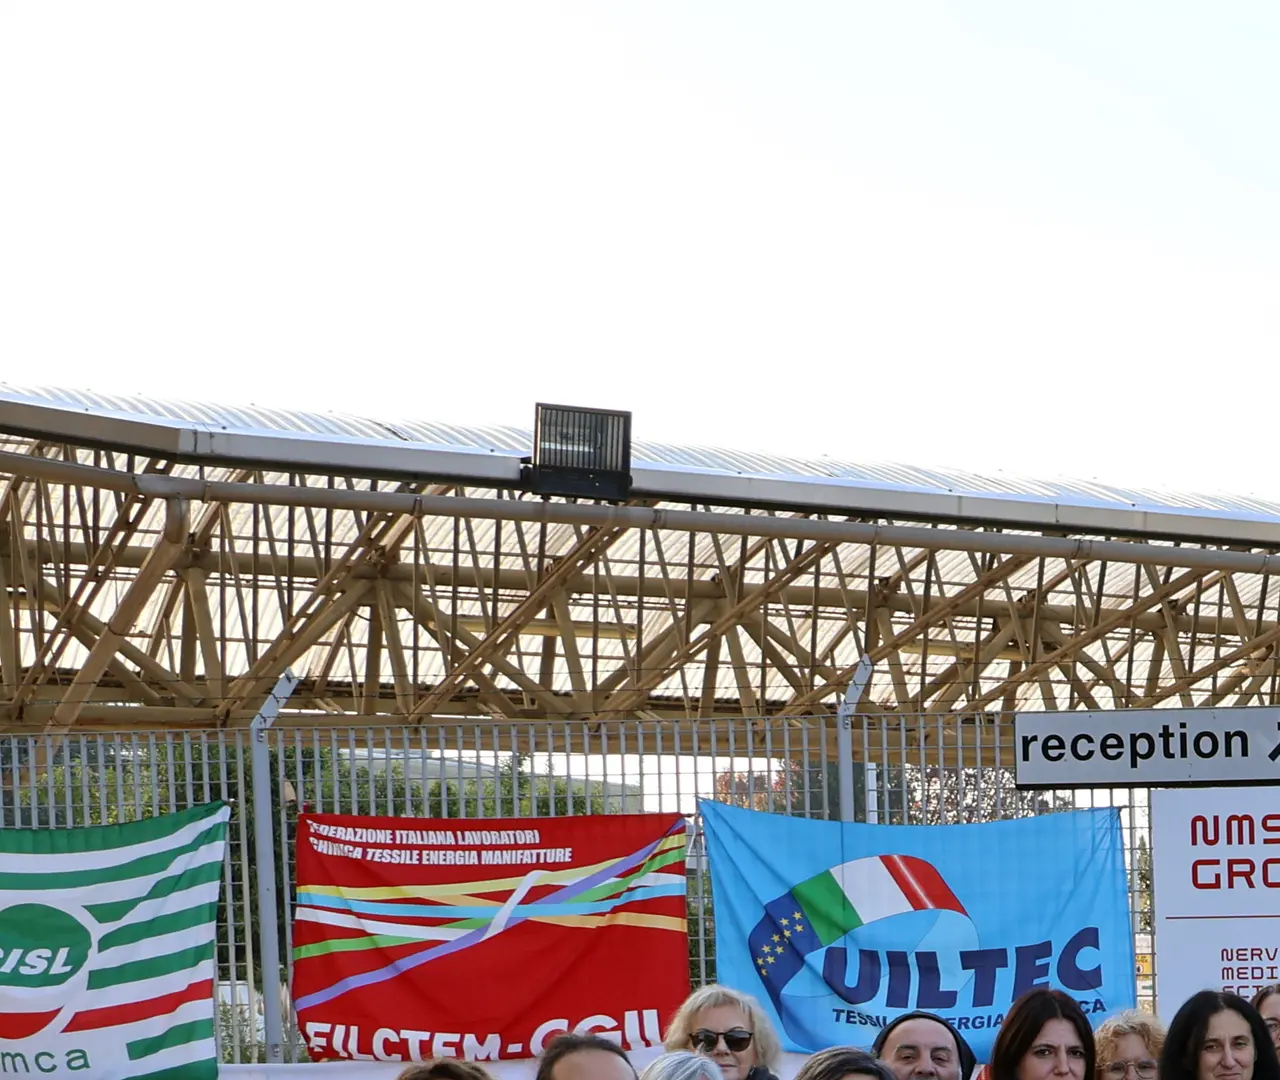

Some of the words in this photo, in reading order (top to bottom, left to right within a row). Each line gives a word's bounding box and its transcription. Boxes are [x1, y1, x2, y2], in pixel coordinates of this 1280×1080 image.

[1021, 722, 1249, 768] reception
[395, 829, 453, 845] ITALIANA
[457, 829, 540, 845] LAVORATORI
[366, 848, 420, 865] TESSILE
[422, 849, 479, 865] ENERGIA
[481, 848, 573, 865] MANIFATTURE
[0, 947, 73, 975] ISL
[822, 926, 1103, 1009] UILTEC
[832, 1008, 888, 1028] TESSIL
